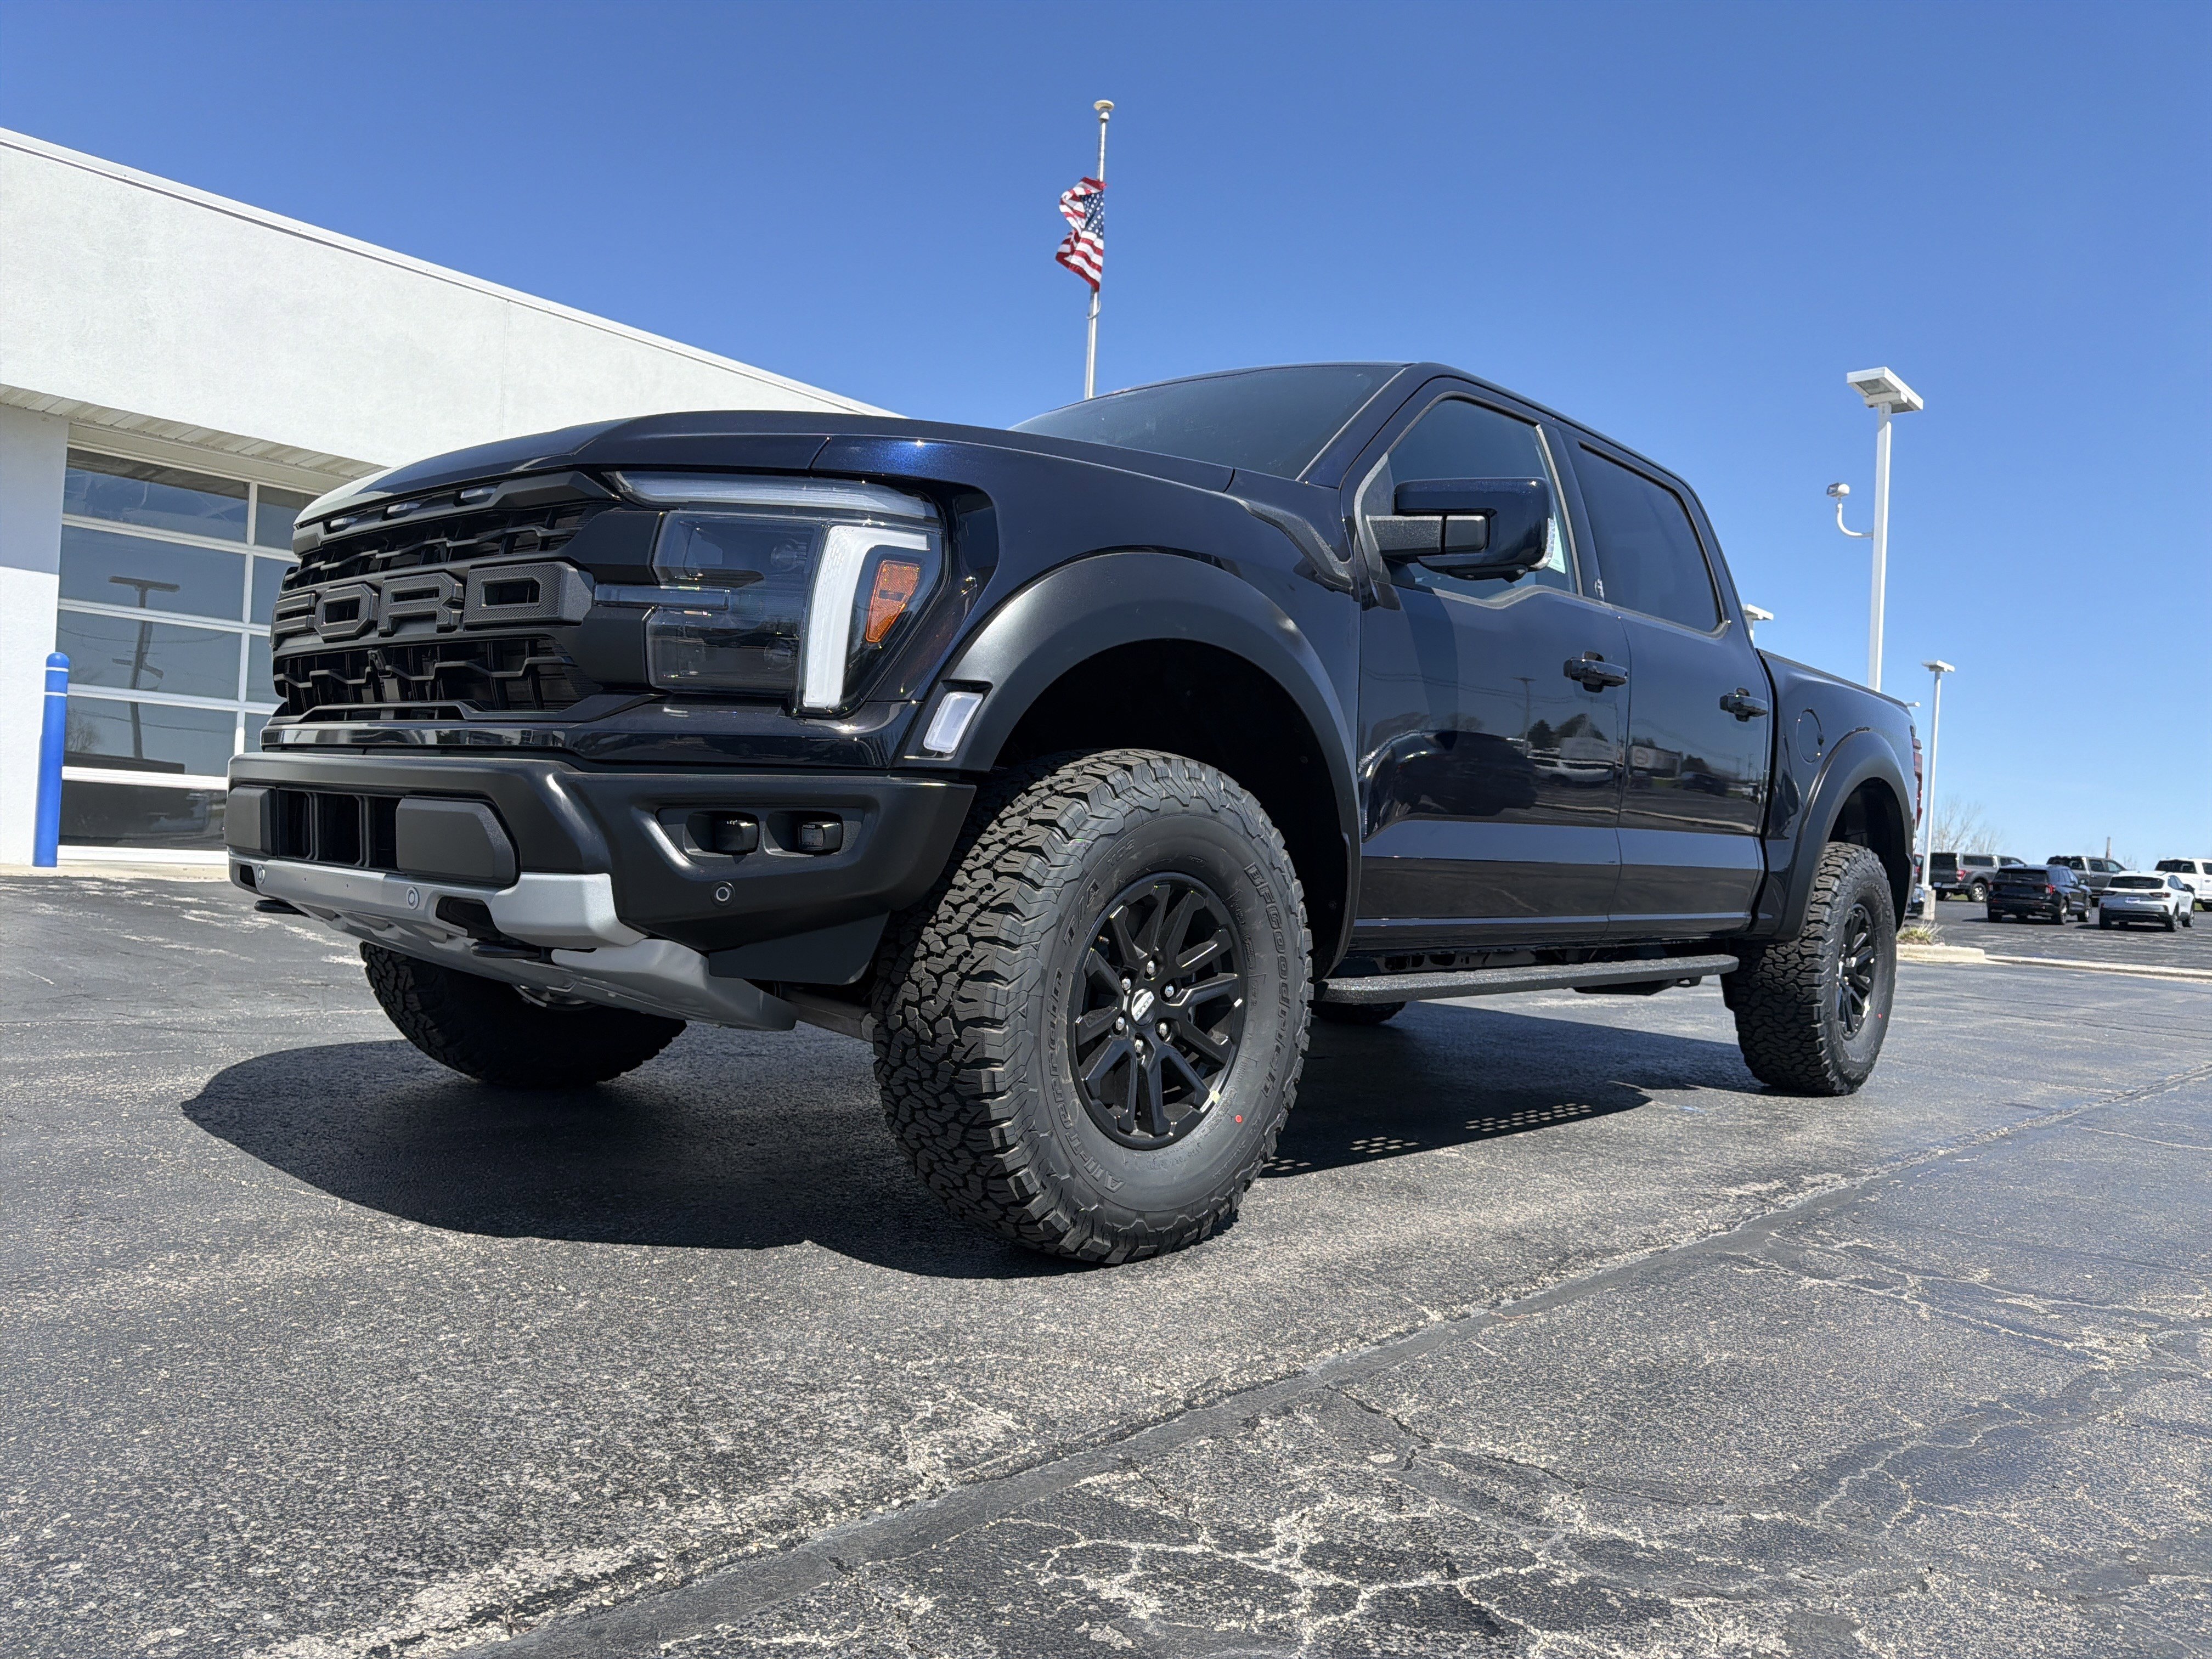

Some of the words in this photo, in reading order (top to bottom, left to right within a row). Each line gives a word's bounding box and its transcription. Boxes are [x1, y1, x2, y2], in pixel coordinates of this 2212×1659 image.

[272, 561, 590, 644] FORD
[1063, 878, 1100, 947] T/A
[1243, 861, 1291, 1099] BFGoodrich
[1047, 967, 1126, 1193] All-Terrain
